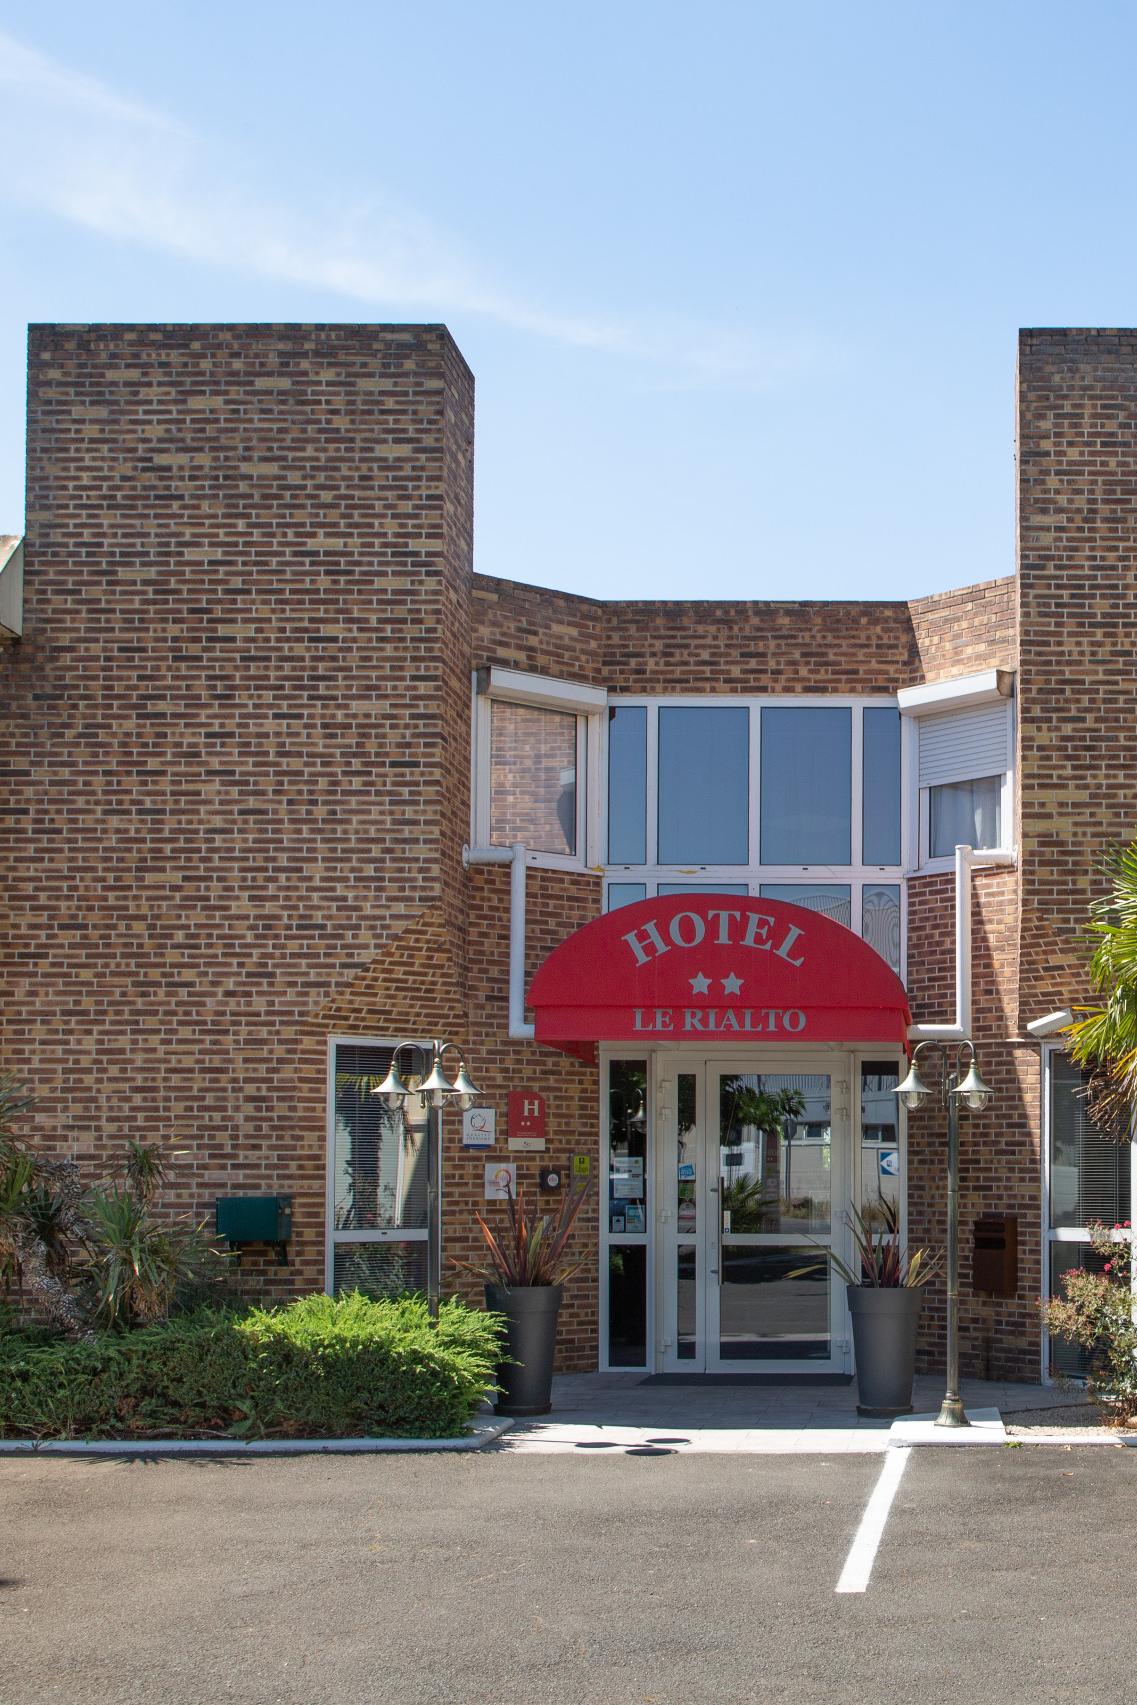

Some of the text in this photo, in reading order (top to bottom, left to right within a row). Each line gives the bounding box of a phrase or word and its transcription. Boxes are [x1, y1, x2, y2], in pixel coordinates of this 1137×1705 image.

[621, 910, 806, 968] HOTEL
[632, 1008, 807, 1032] LE RIALTO
[522, 1099, 539, 1117] H
